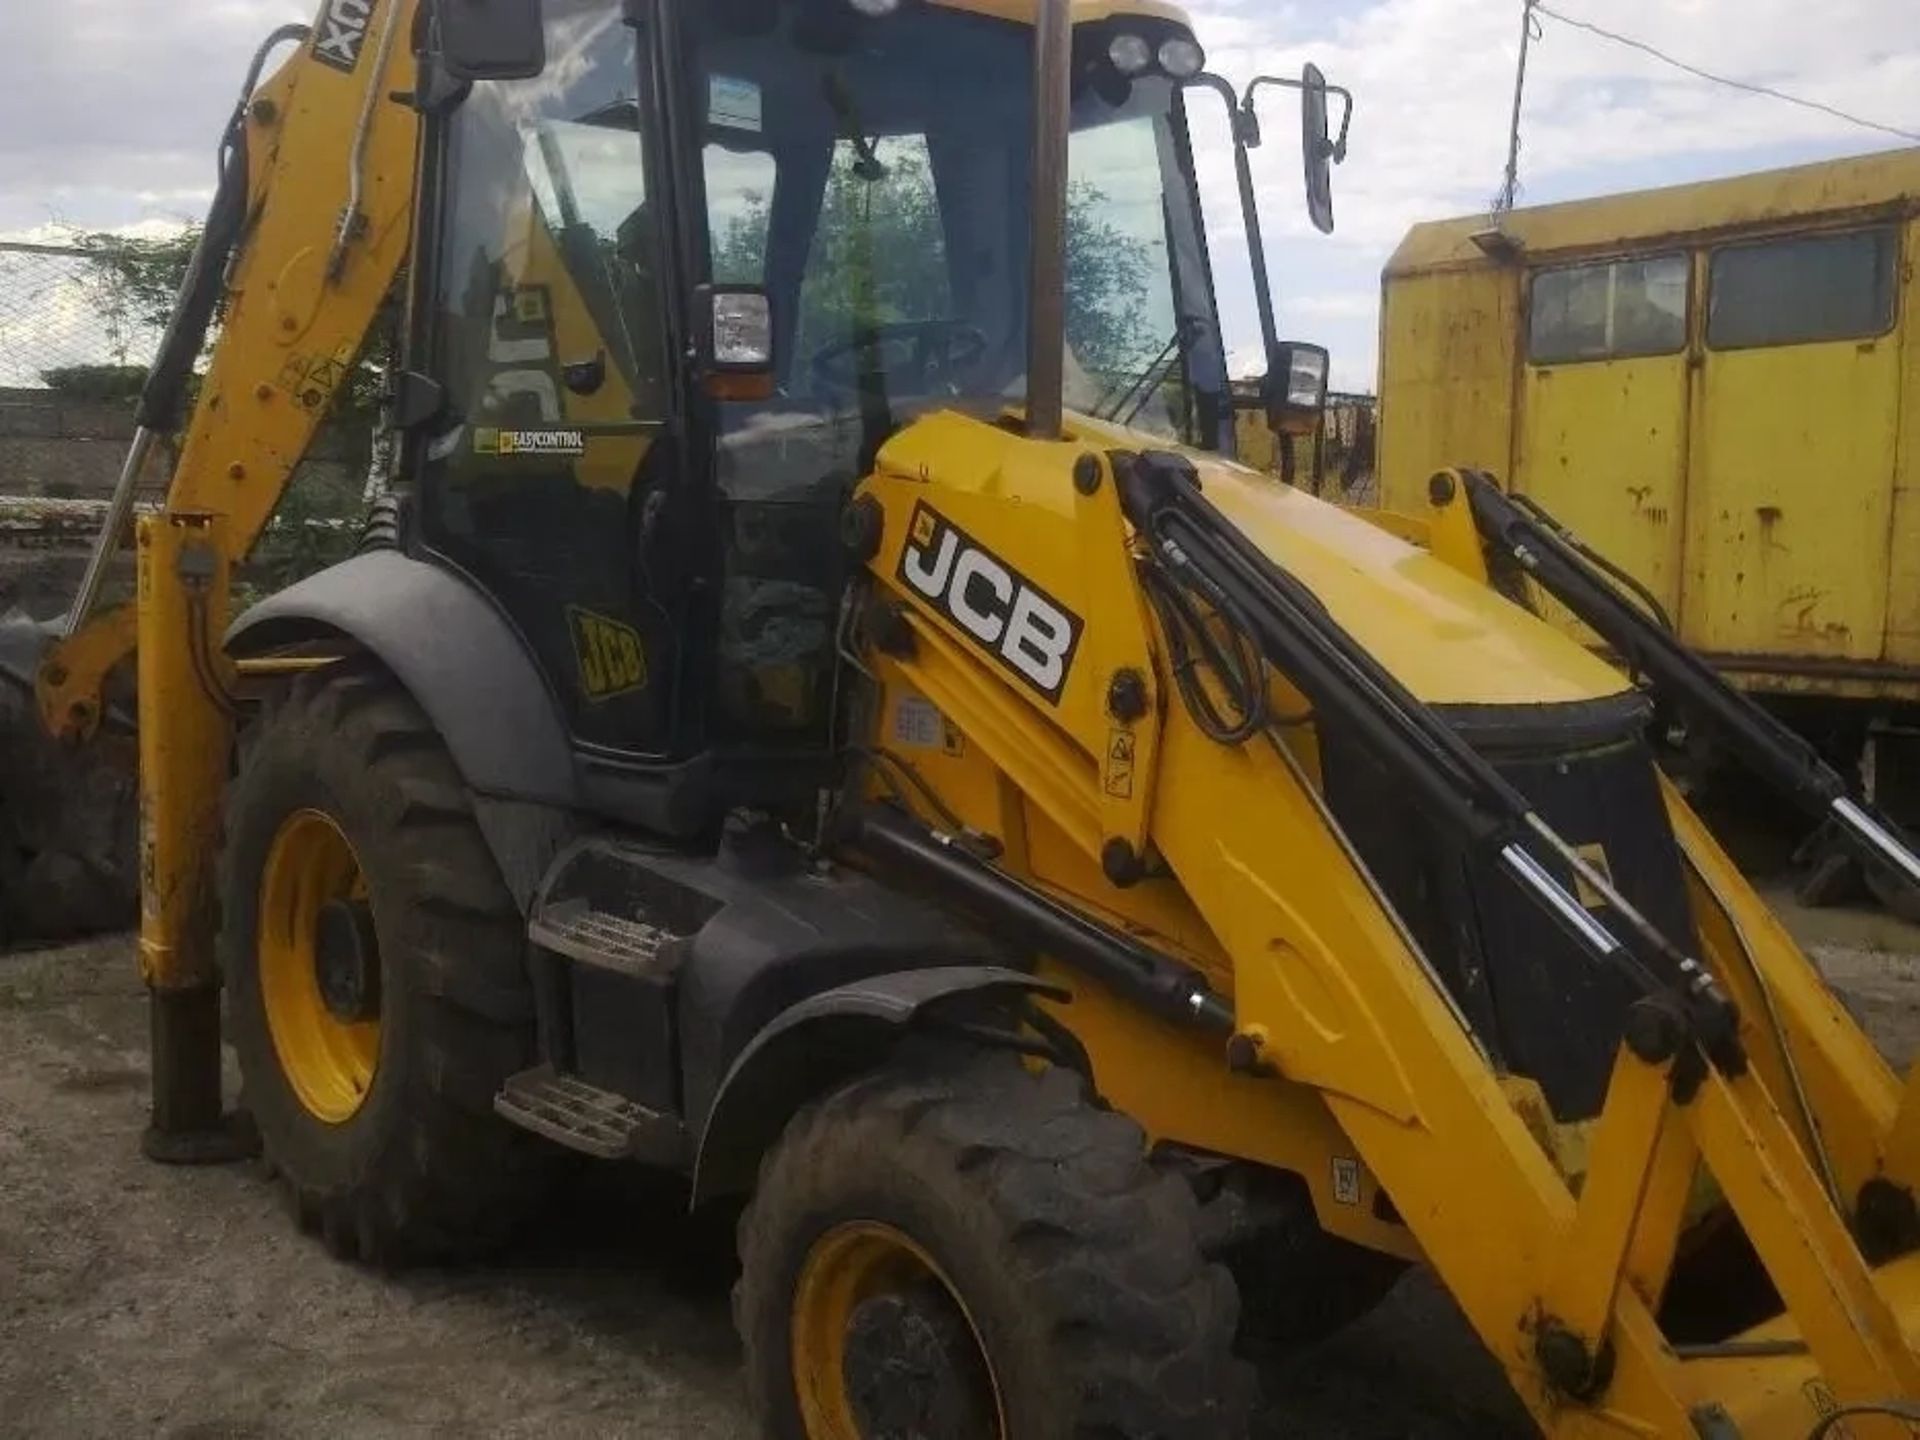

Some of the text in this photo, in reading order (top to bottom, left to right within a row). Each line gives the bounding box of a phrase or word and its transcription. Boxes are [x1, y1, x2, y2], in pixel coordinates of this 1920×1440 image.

[513, 431, 583, 450] EASYCONTROL
[904, 527, 1072, 690] JCB
[579, 615, 641, 692] JCB
